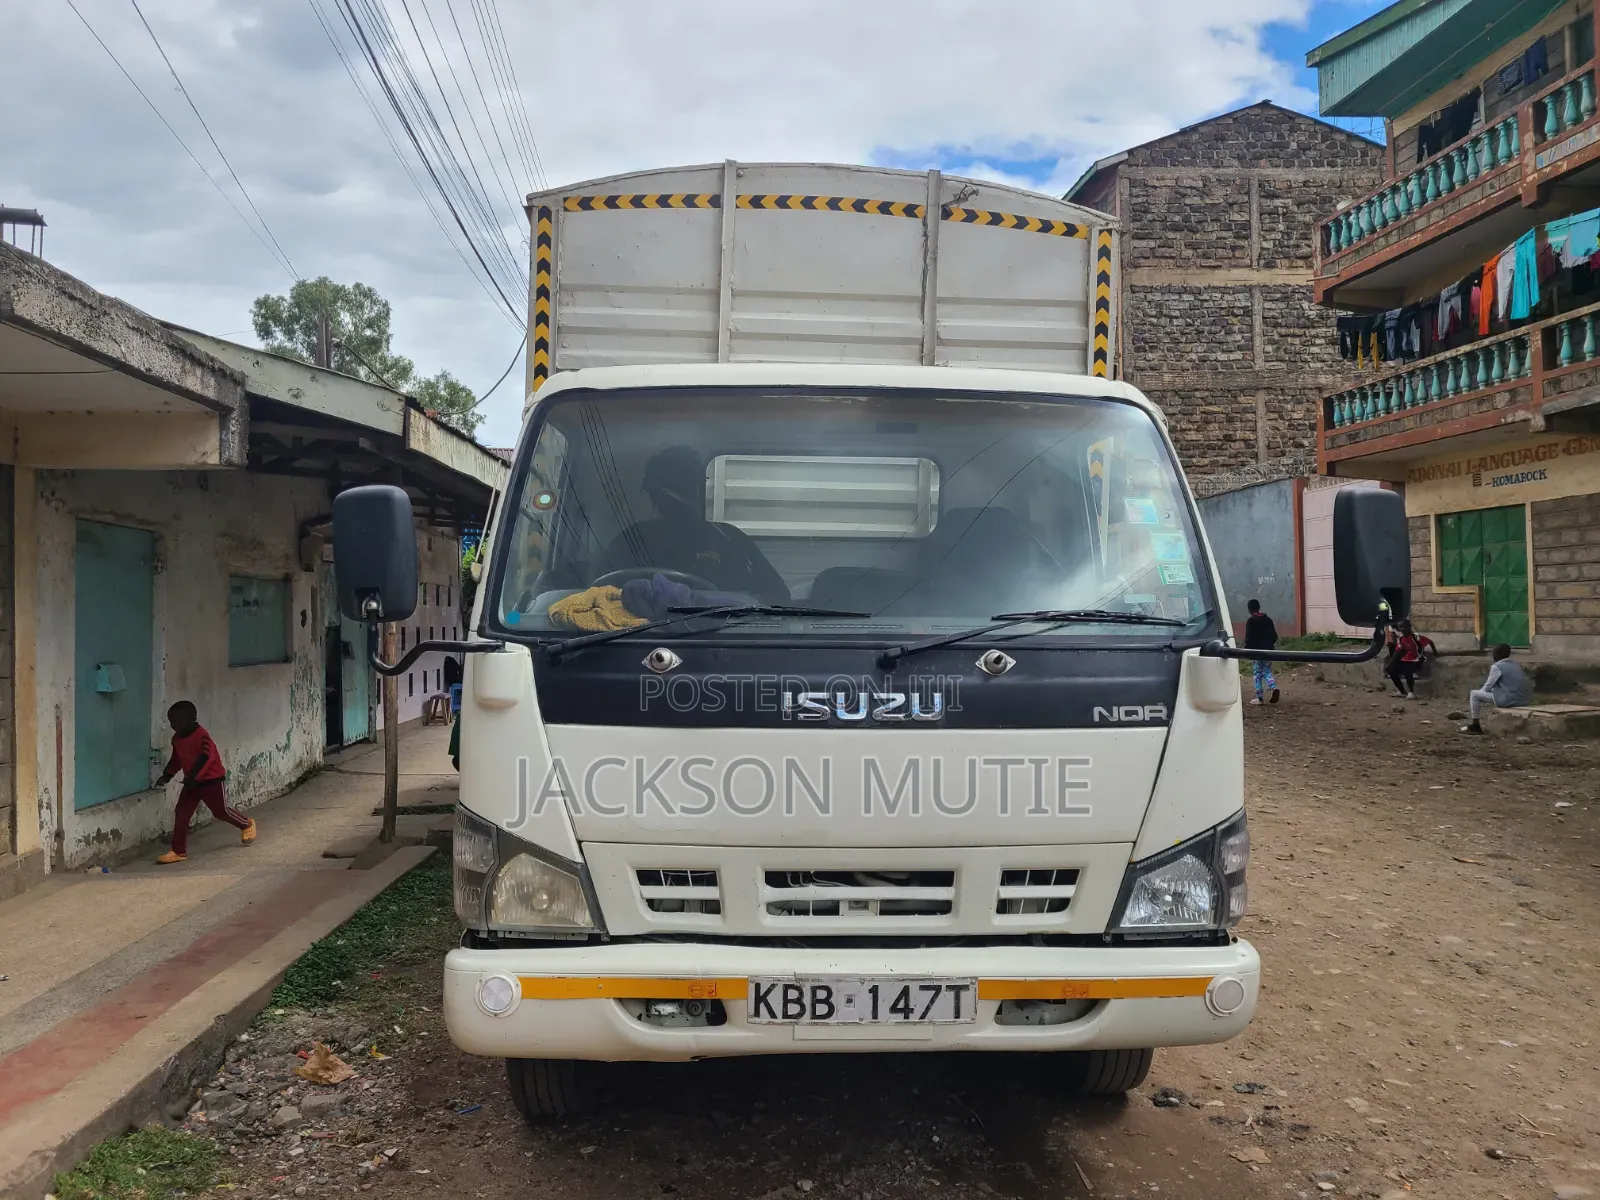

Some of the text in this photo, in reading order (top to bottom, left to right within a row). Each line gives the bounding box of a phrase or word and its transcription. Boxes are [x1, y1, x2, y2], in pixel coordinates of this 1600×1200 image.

[1407, 461, 1461, 484] ADONAI
[1465, 443, 1559, 475] LANGUAGE
[782, 692, 942, 721] ISUZU
[1093, 705, 1168, 722] NQR
[754, 982, 970, 1020] KBB 147T
